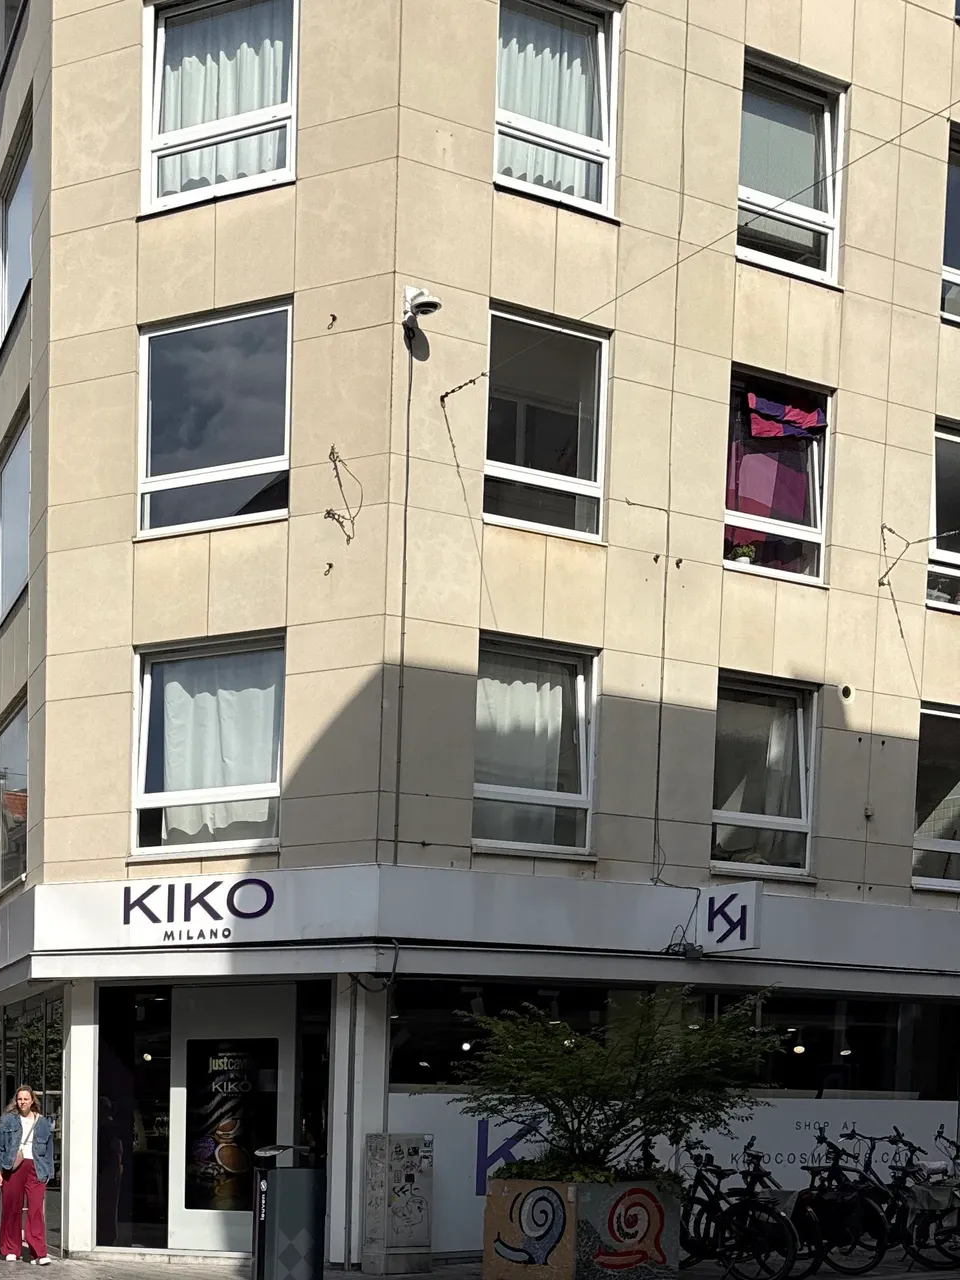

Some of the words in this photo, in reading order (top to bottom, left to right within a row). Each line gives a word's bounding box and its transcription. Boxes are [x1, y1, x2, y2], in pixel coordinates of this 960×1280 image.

[123, 878, 275, 925] KIKO
[163, 928, 232, 941] MILANO
[211, 1081, 253, 1093] KIKO
[795, 1121, 830, 1131] SHOP
[841, 1121, 857, 1131] AT
